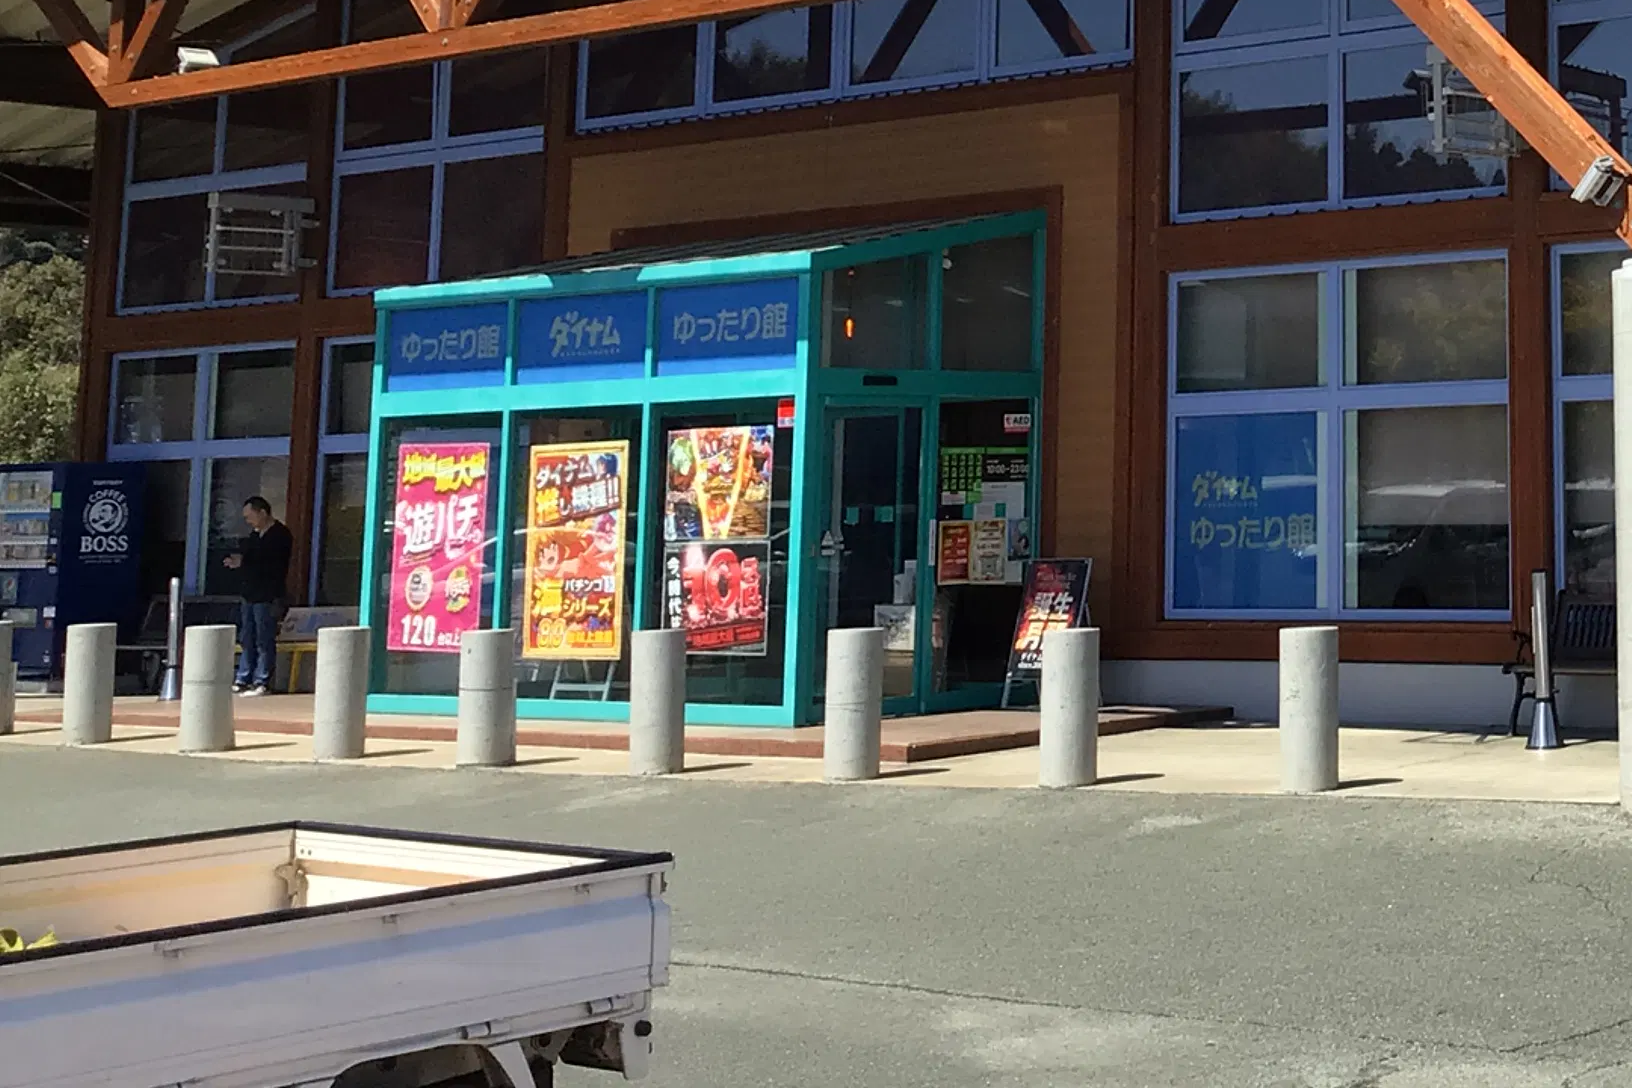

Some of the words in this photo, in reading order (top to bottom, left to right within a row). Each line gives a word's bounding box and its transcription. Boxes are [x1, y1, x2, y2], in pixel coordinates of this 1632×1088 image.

[550, 311, 621, 357] ダイナム
[673, 302, 789, 344] ゆったり館
[402, 324, 500, 362] ゆったり館
[1013, 417, 1029, 425] AED
[88, 489, 126, 503] COFFEE
[1192, 470, 1258, 506] ダイナム
[80, 535, 128, 552] BOSS
[1190, 513, 1315, 550] ゆったり館
[562, 596, 613, 618] シリーズ
[401, 615, 435, 646] 120
